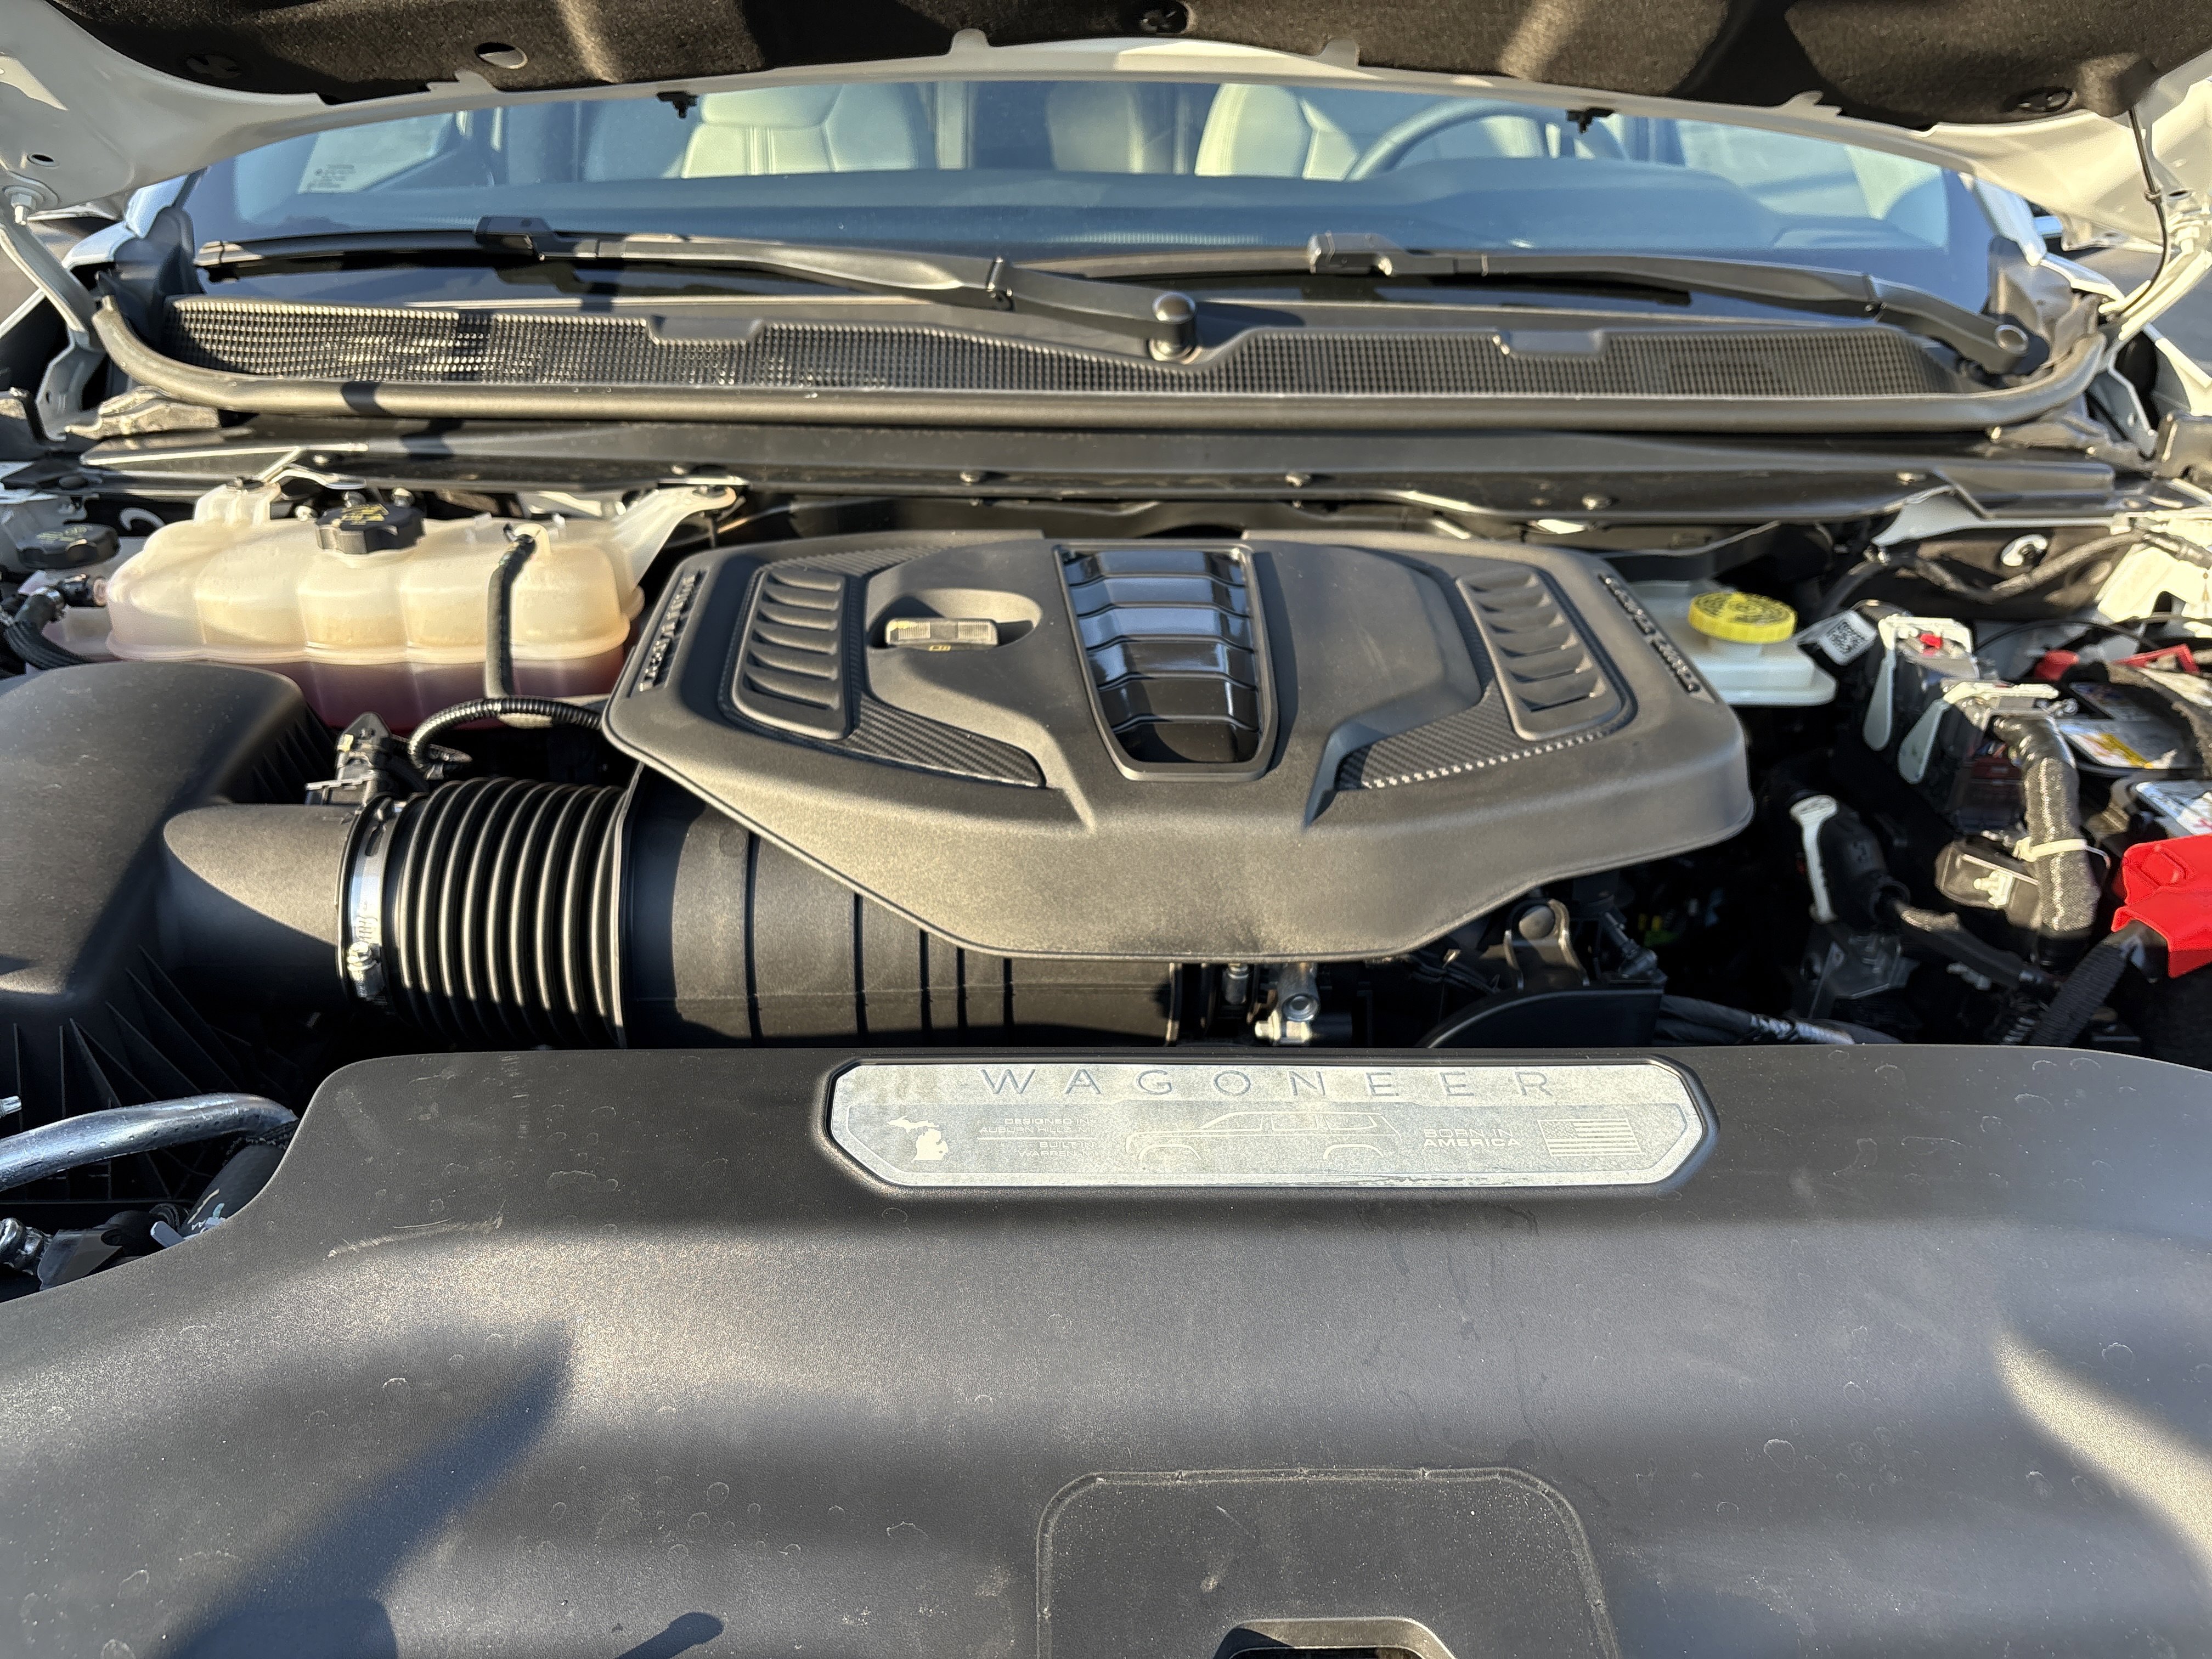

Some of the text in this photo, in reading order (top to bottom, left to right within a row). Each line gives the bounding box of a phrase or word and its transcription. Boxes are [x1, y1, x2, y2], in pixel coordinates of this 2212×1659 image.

[980, 1068, 1553, 1097] WAGONEER
[1424, 1128, 1514, 1138] BORN IN
[1423, 1138, 1522, 1148] AMERICA
